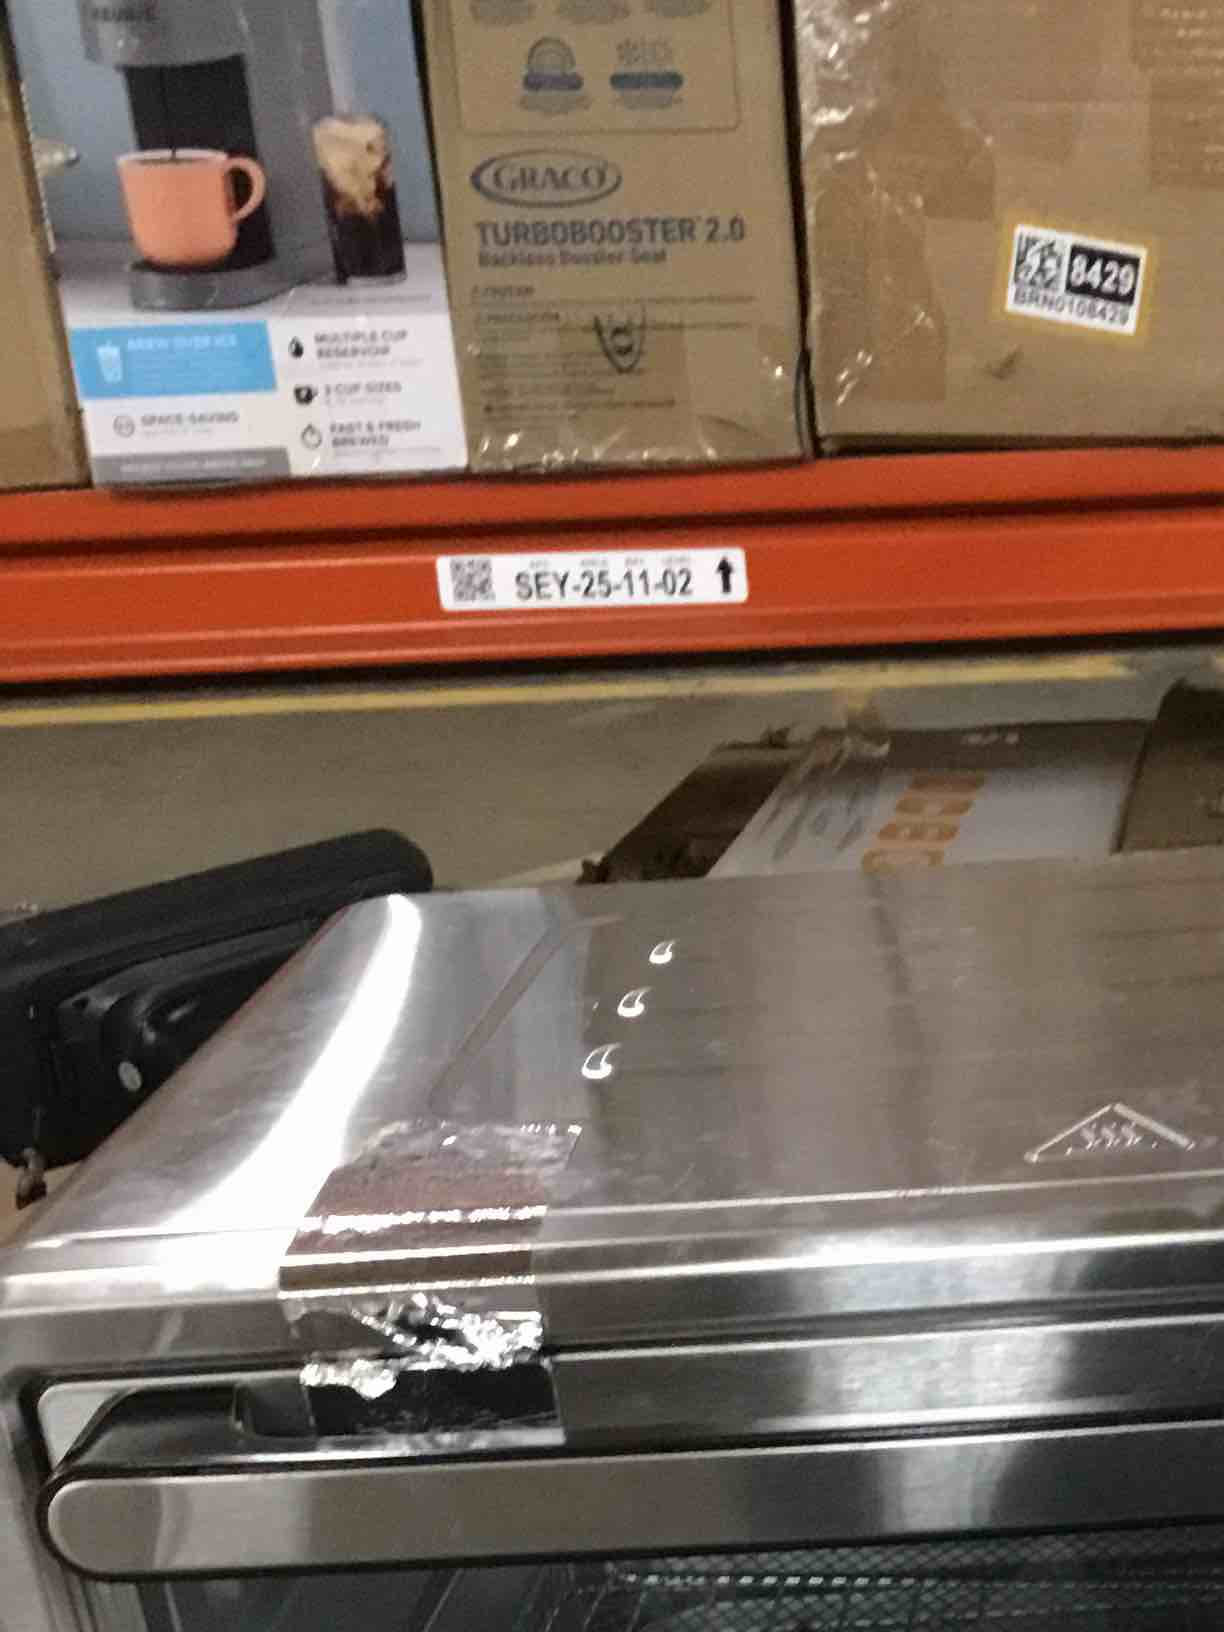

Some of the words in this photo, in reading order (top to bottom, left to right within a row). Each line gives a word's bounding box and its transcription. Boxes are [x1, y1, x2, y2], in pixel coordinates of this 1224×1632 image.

[492, 165, 607, 192] GRACO
[475, 216, 698, 247] TURBOBOOSTER
[705, 214, 746, 243] 2.0
[1070, 253, 1136, 296] 8429
[381, 330, 408, 342] CUP
[514, 567, 694, 600] SEY-25-11-02
